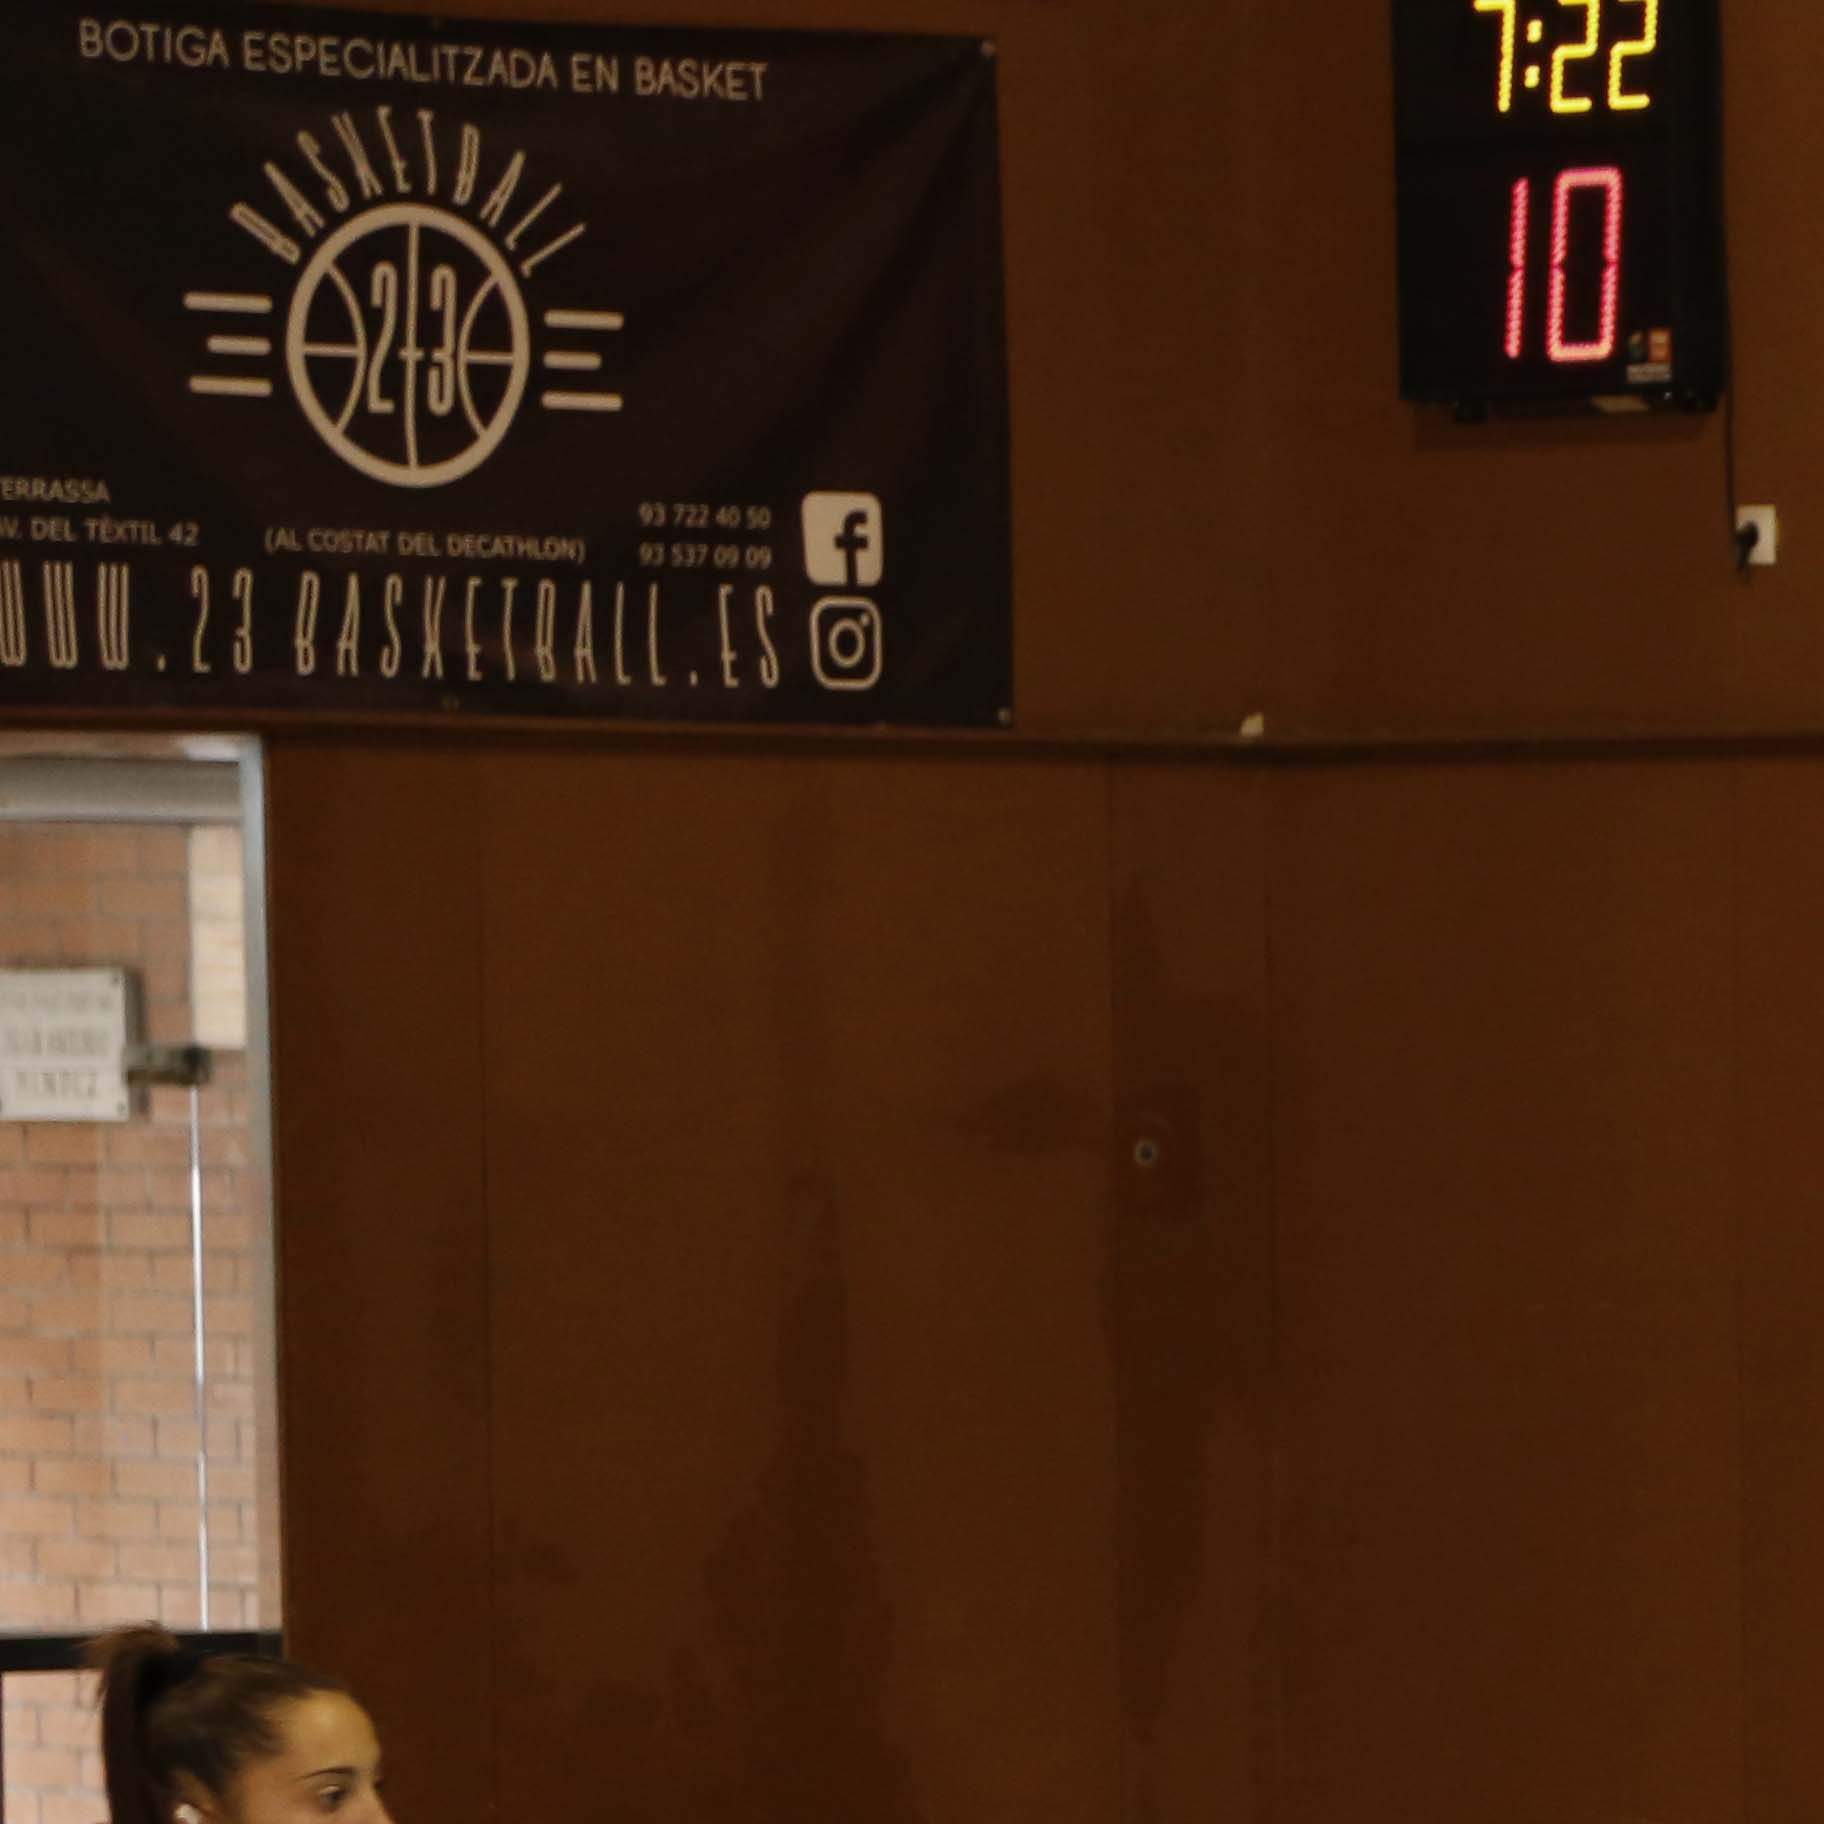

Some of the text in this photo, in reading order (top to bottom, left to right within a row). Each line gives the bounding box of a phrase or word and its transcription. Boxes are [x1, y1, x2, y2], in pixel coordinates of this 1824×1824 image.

[79, 16, 769, 100] BOTIGA ESPECIALITZADA EN BASKET
[1474, 0, 1658, 112] 7:22
[229, 105, 588, 278] BASKETBALL
[1504, 165, 1623, 362] 10
[367, 260, 457, 416] 23
[0, 476, 111, 504] ERRASSA
[638, 500, 666, 527] 93
[30, 516, 78, 542] DEL
[167, 520, 200, 547] 42
[307, 527, 390, 554] COSTAT
[397, 531, 440, 557] DEL
[447, 532, 587, 565] DECATHLON)
[638, 541, 664, 567] 93
